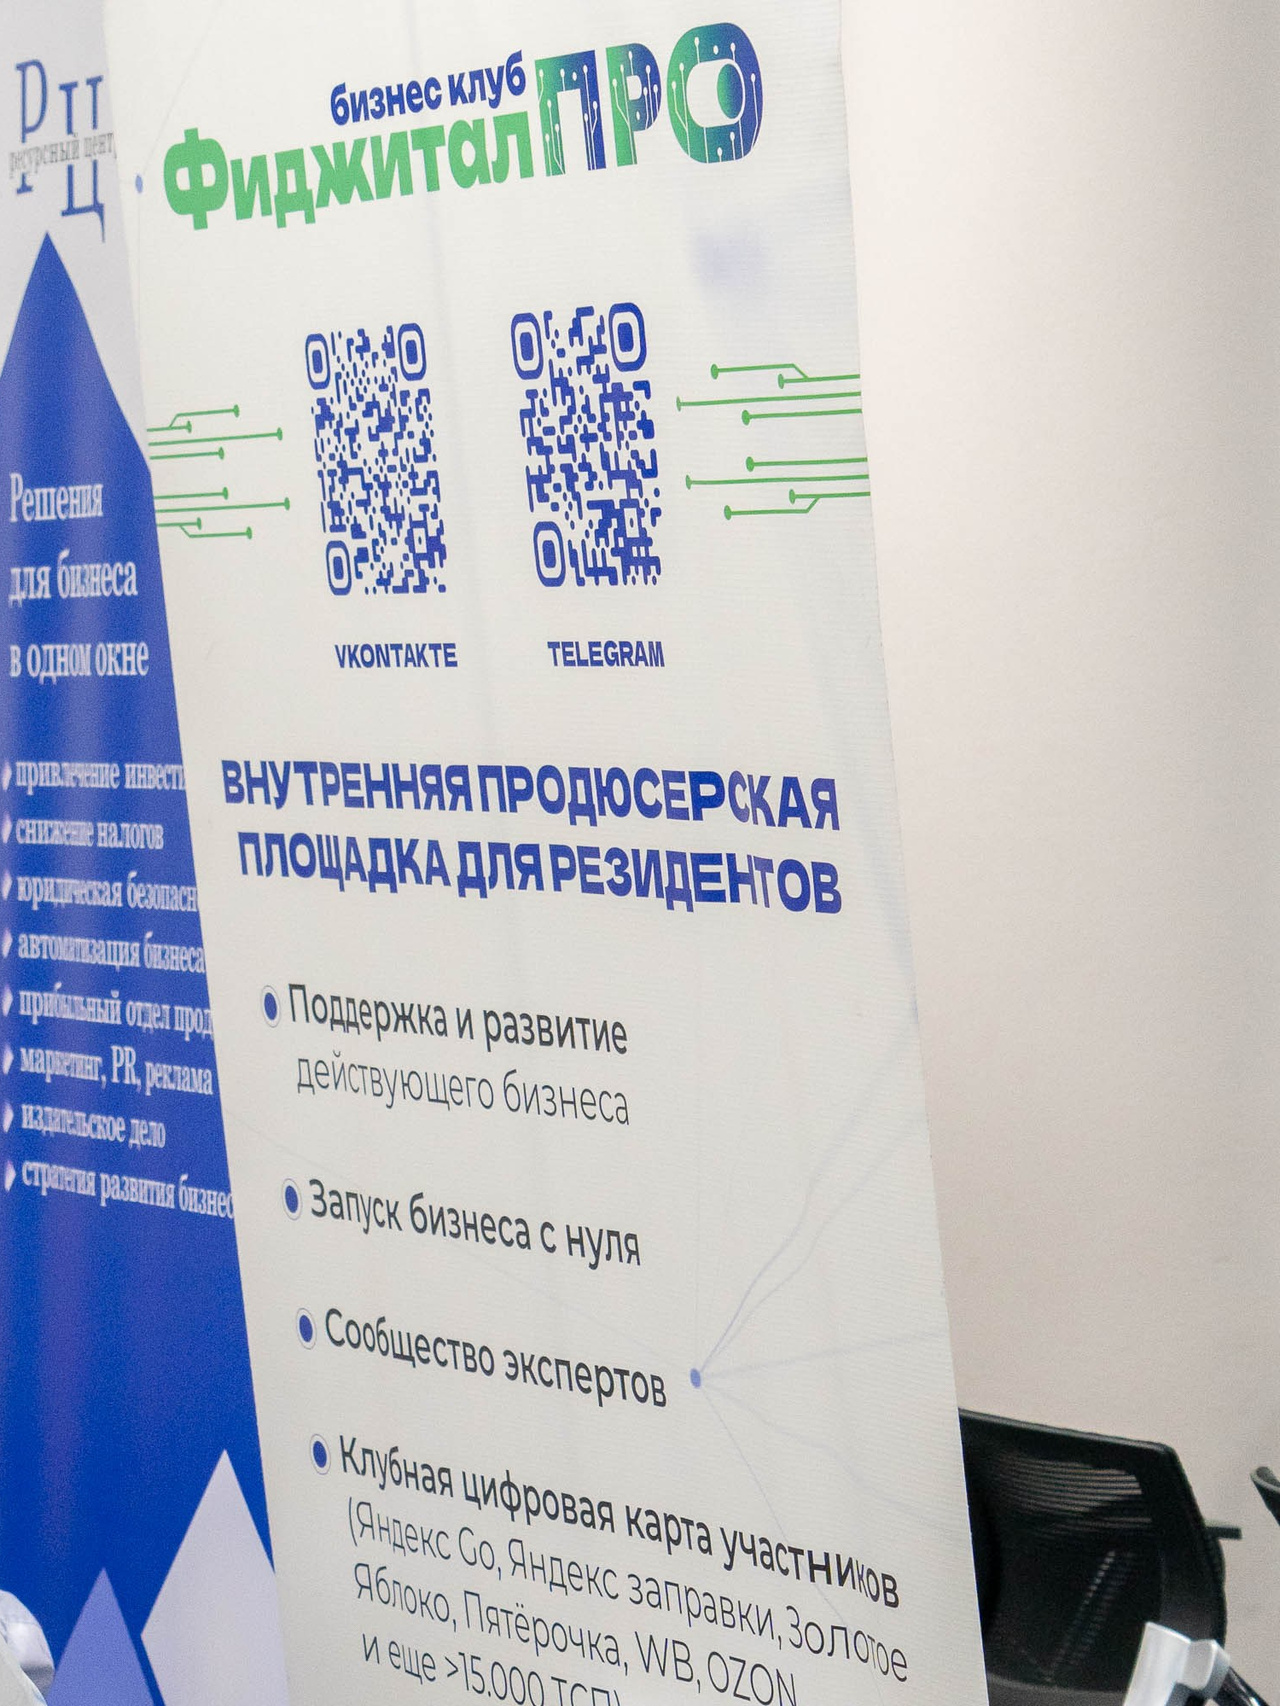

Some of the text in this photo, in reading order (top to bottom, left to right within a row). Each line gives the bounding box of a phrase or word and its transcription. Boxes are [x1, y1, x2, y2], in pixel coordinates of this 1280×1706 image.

[330, 49, 526, 126] бизнес клуб
[15, 58, 105, 243] РЦ
[84, 132, 117, 160] цент
[9, 472, 103, 523] Решения
[8, 548, 138, 608] для бизнеса
[9, 642, 149, 685] в одном окне
[334, 642, 458, 669] VKONTAKTE
[547, 640, 665, 668] TELEGRAM
[15, 761, 120, 795] привлечение
[220, 759, 841, 831] ВНУТРЕННЯЯ ПРОДЮСЕРСКАЯ
[16, 819, 164, 850] снижение налогов
[17, 871, 199, 912] юридическая безопасн
[237, 831, 842, 914] ПЛОЩАДКА ДЛЯ РЕЗИДЕНТОВ
[18, 931, 206, 974] автоматизация бизнеса
[19, 982, 122, 1025] прибыльный
[125, 1000, 171, 1034] отдел
[288, 983, 629, 1055] Поддержка и развитие
[20, 1045, 213, 1096] маркетинг, PR, реклама
[297, 1050, 630, 1126] действующего бизнеса
[21, 1104, 166, 1151] издательское дело
[21, 1161, 96, 1196] стратегия
[100, 1173, 175, 1210] развития
[309, 1179, 641, 1270] Запуск бизнеса с нуля
[325, 1308, 668, 1408] Сообщество экспертов
[339, 1435, 901, 1609] Клубная цифровая карта участников
[348, 1496, 909, 1682] (Яндекс Go, Яндекс заправки, Золотое
[354, 1562, 457, 1631] Яблоко,
[463, 1590, 630, 1677] Пятёрочка,
[636, 1631, 702, 1694] WB,
[362, 1631, 381, 1664] и
[388, 1640, 437, 1686] еще
